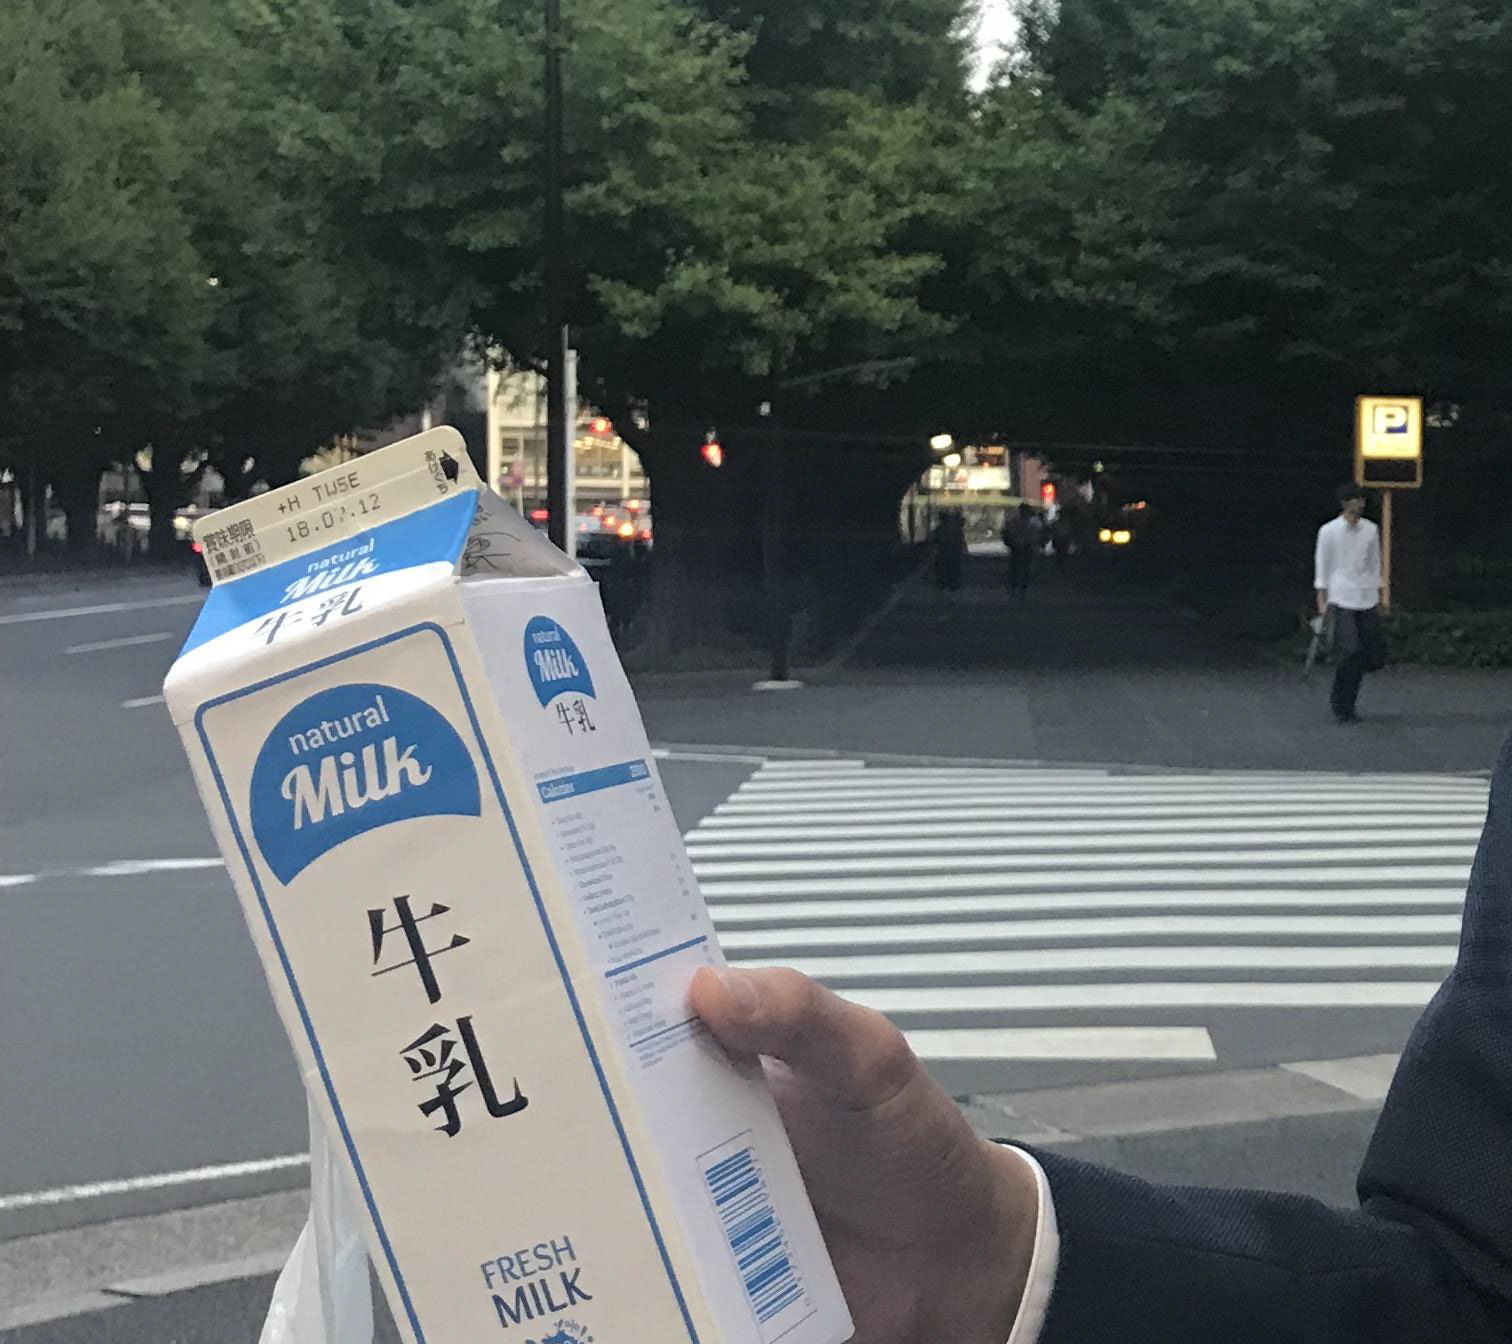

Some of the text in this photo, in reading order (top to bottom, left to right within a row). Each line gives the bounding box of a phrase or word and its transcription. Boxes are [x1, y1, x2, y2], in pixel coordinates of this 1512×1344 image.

[1375, 406, 1407, 433] P
[279, 556, 381, 604] Milk
[307, 538, 375, 572] natural
[255, 587, 364, 645] 牛乳
[532, 626, 562, 644] natural
[534, 648, 579, 683] Milk
[289, 694, 390, 755] natural
[556, 699, 596, 735] 牛乳
[281, 735, 433, 830] Milk
[367, 894, 529, 1137] 牛乳
[480, 1235, 577, 1290] FRESH
[492, 1267, 593, 1328] MILK
